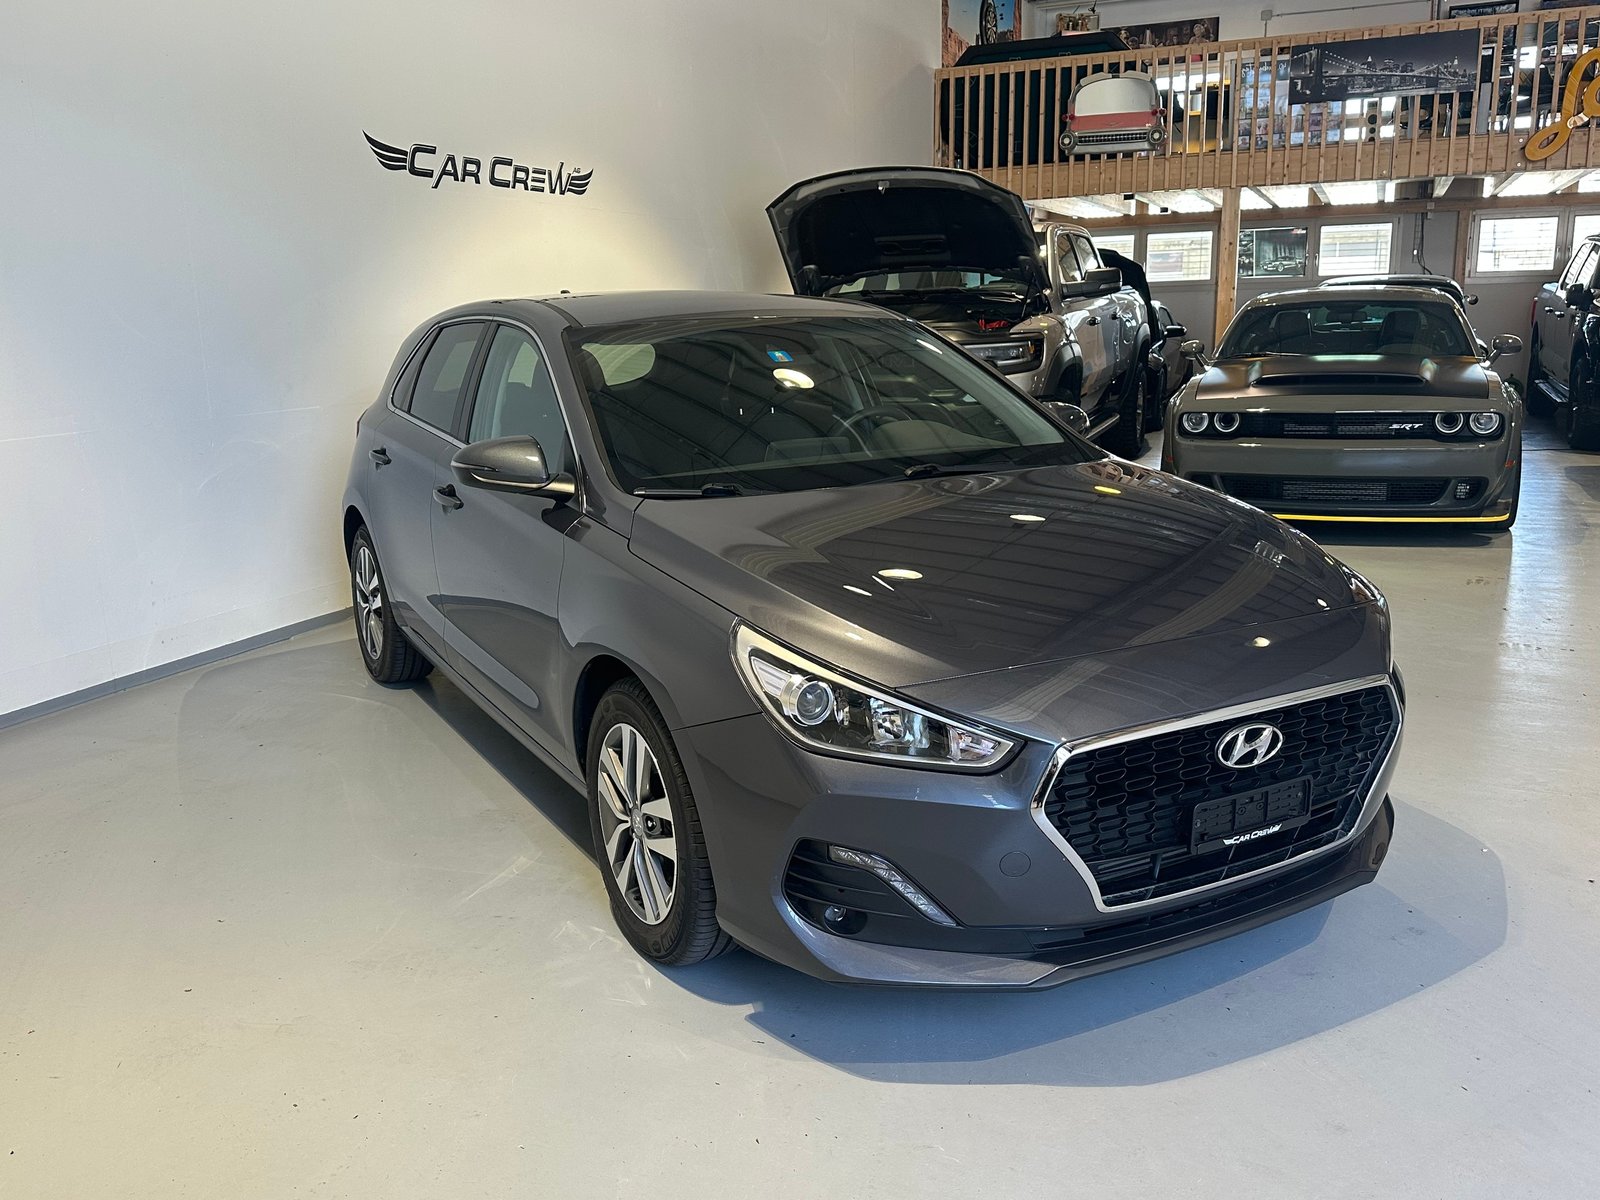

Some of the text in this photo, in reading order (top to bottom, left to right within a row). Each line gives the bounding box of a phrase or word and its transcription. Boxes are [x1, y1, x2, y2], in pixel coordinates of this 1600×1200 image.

[408, 143, 572, 196] CAR CREW
[1389, 423, 1424, 431] SRT
